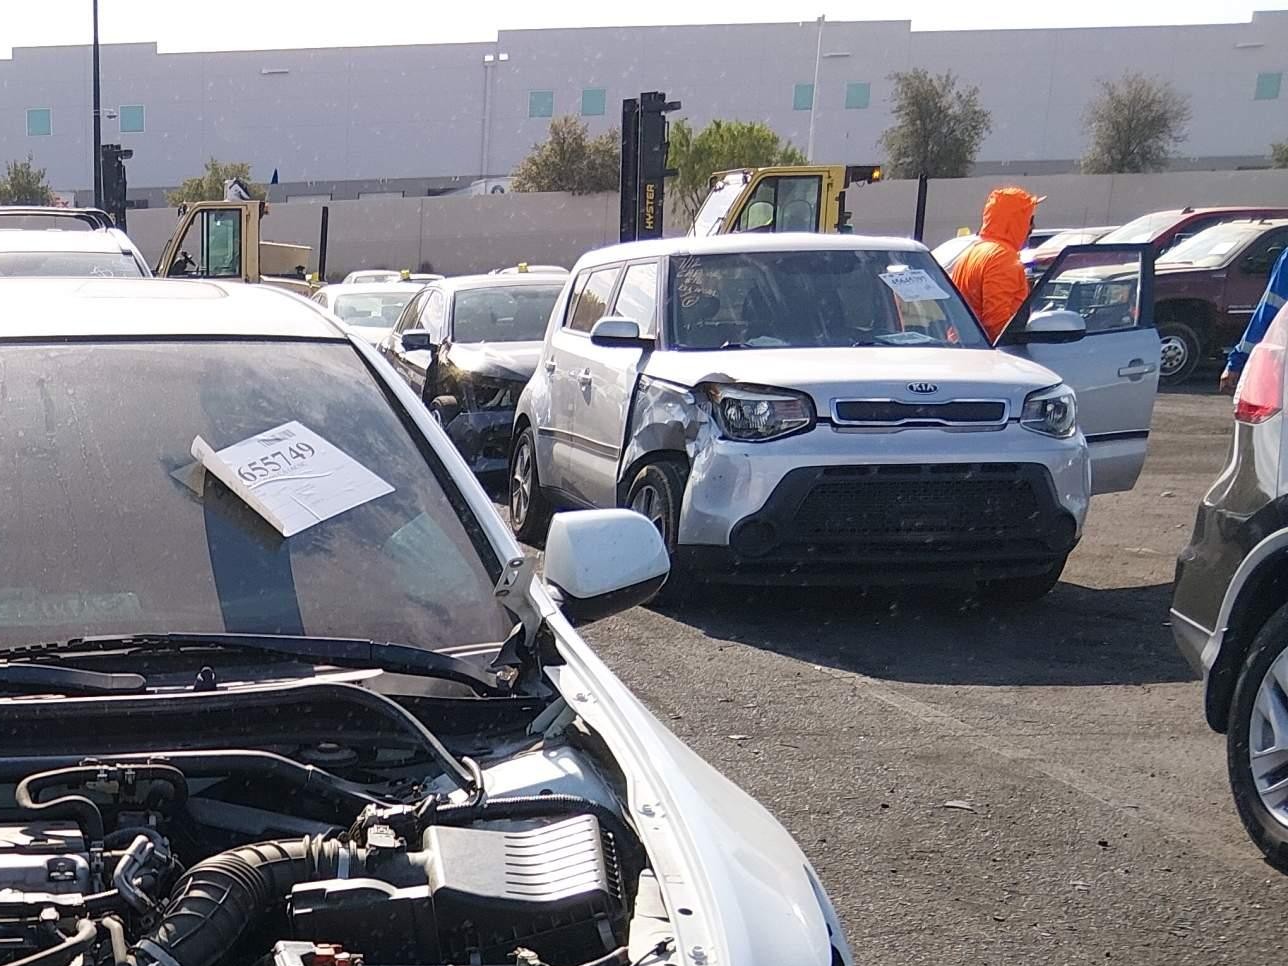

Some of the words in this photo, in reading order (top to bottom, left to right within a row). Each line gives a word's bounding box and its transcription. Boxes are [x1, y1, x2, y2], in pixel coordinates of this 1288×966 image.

[645, 184, 655, 229] HYSTER
[912, 382, 935, 392] KIA
[237, 442, 315, 482] 655749
